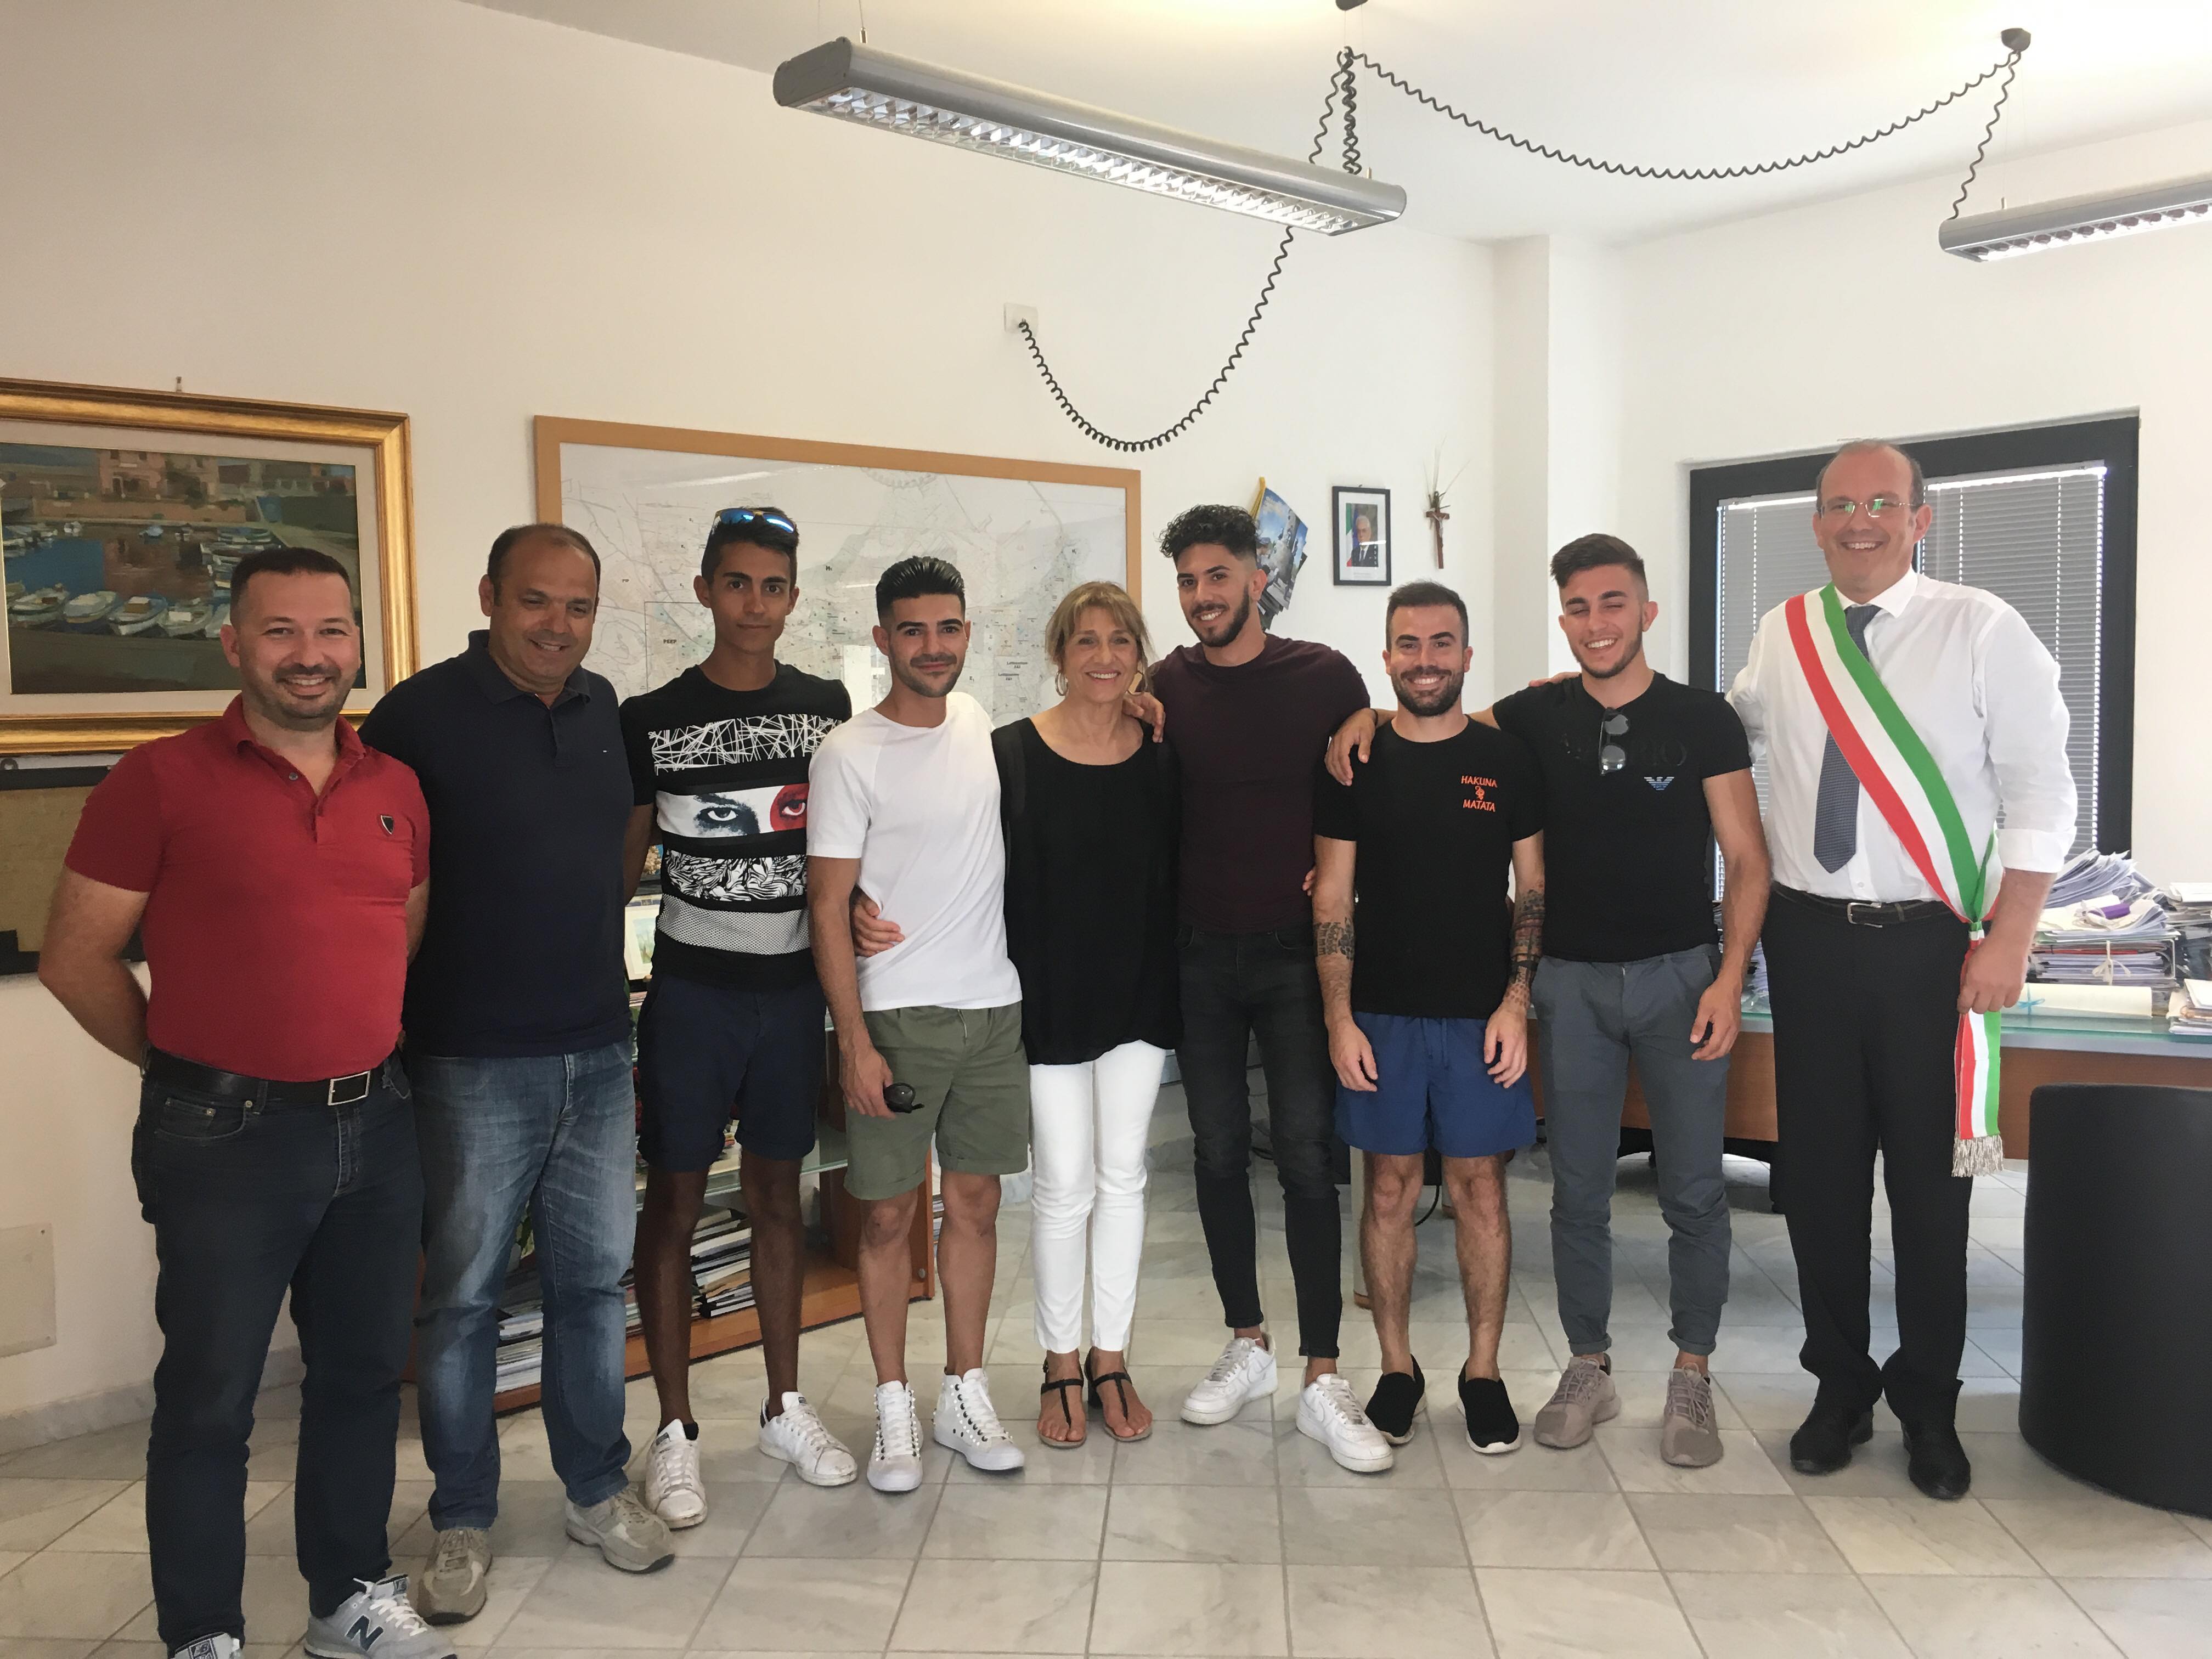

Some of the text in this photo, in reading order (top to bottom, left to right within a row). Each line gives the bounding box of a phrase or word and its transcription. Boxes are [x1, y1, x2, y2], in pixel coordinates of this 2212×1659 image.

[1461, 775, 1498, 788] HAKUNA
[1463, 799, 1496, 812] MATATA
[345, 1615, 383, 1651] N
